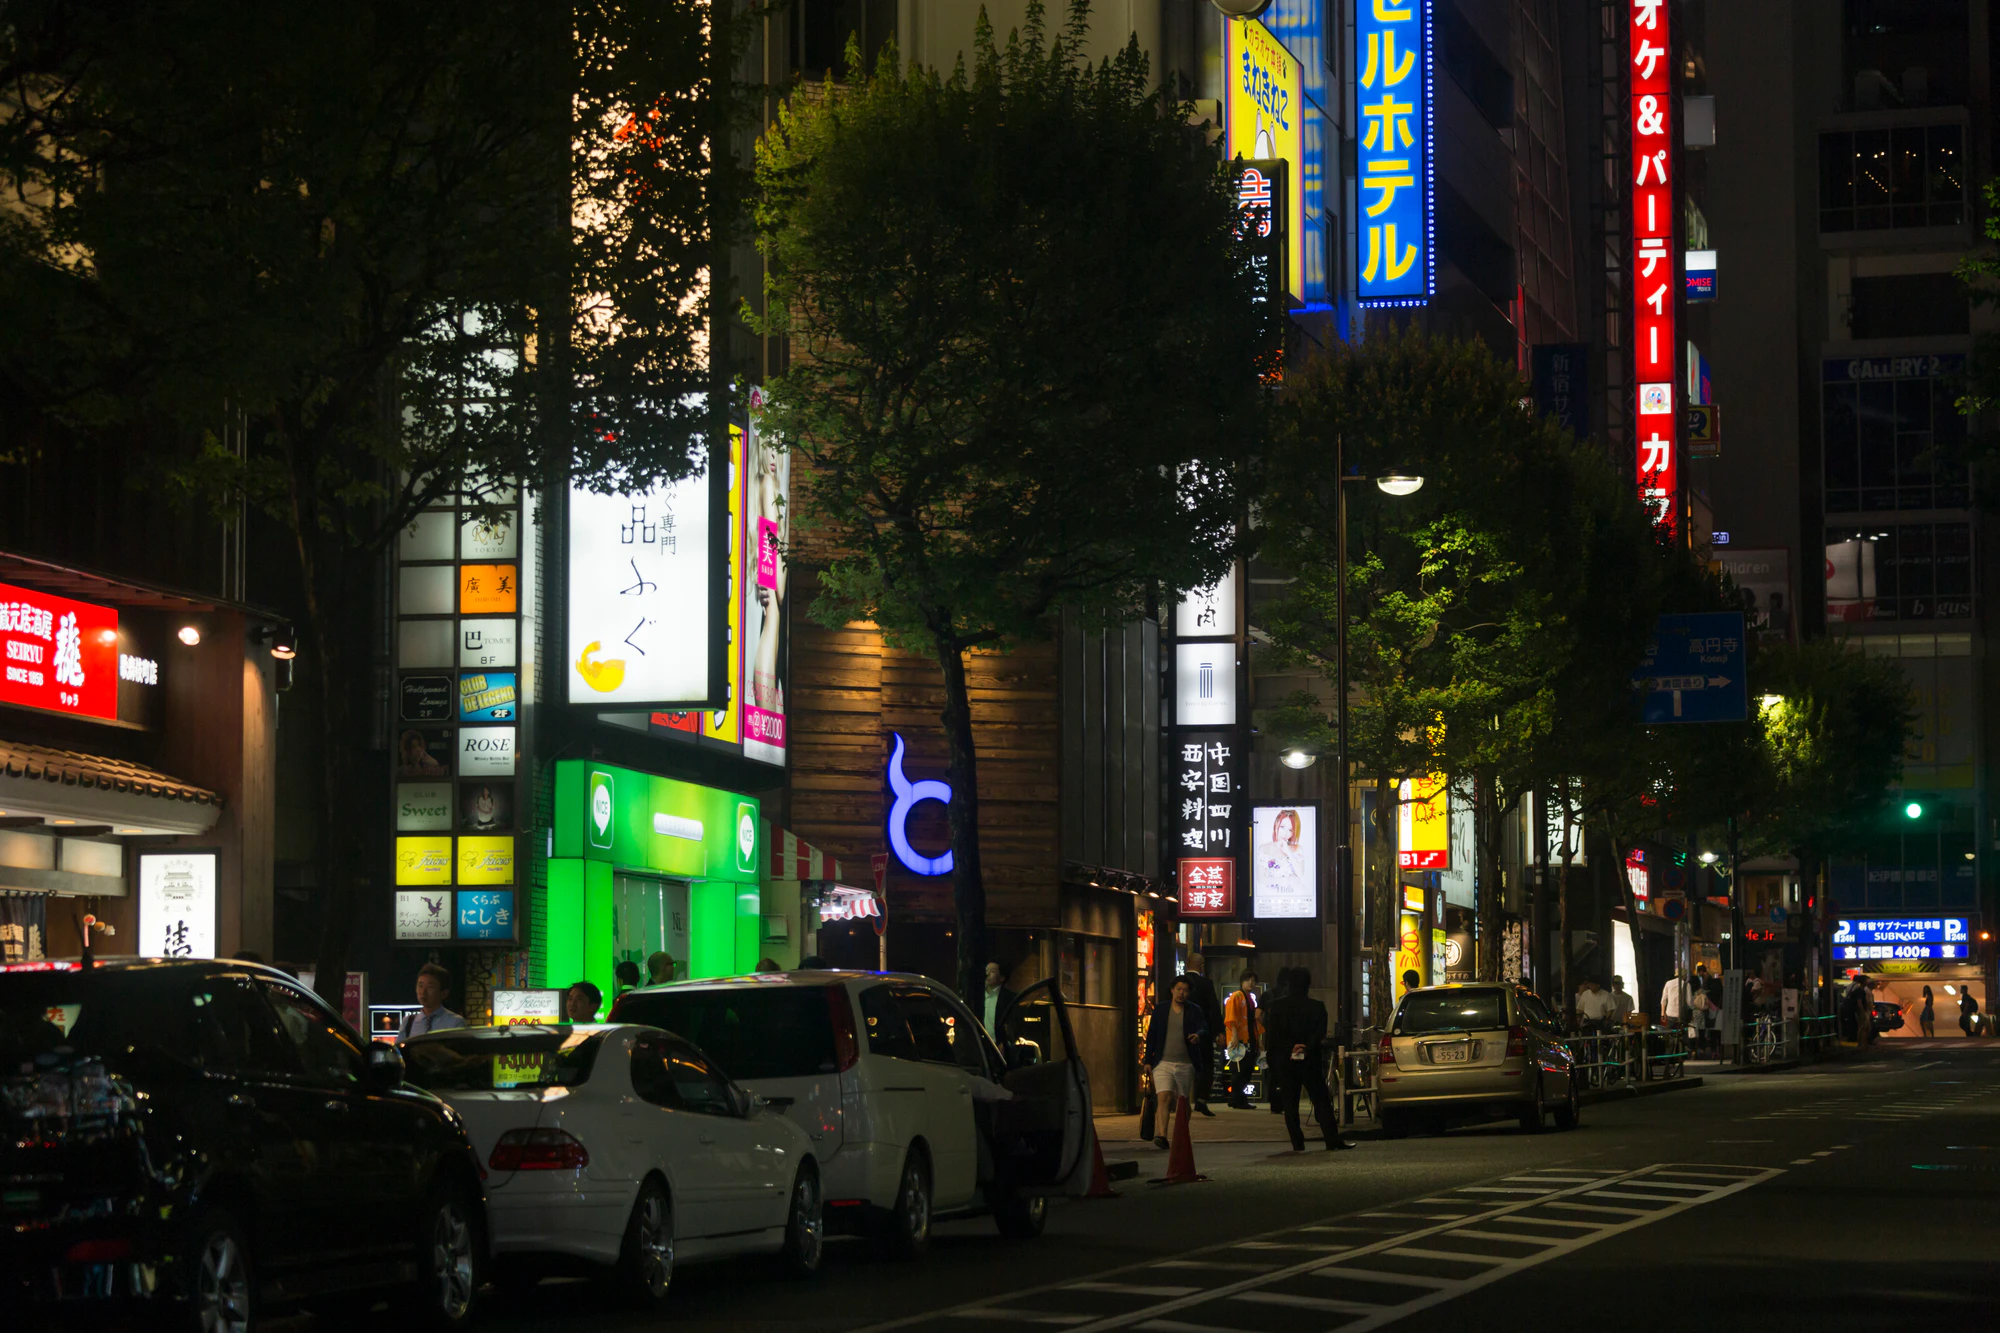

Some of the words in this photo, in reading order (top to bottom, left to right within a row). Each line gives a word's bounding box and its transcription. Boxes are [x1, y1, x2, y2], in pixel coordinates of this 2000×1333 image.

[1242, 46, 1289, 131] まねきねこ
[7, 641, 43, 663] SEIRYU
[1689, 637, 1739, 654] 高円寺
[480, 656, 496, 664] 8F
[1700, 655, 1728, 664] Koenji
[7, 666, 28, 683] SINCE
[405, 685, 448, 694] Hollywood
[460, 674, 488, 695] CLUB
[419, 697, 448, 706] Lounge
[478, 685, 516, 711] LEGEND
[494, 709, 508, 718] 2F
[465, 738, 511, 751] ROSE
[1181, 744, 1204, 850] 西安料理
[1208, 741, 1232, 848] 中国四川
[402, 803, 448, 817] Sweet
[1399, 853, 1418, 866] B1
[472, 894, 505, 905] くらぶ
[461, 908, 510, 926] にしき
[1858, 920, 1941, 931] 新宿サブナード駐車場
[1944, 919, 1962, 941] P
[479, 929, 492, 937] 2F
[1839, 934, 1855, 942] 24H
[1874, 931, 1925, 942] SUBNADE
[1951, 933, 1966, 941] 24H
[1441, 1051, 1465, 1060] 55-23
